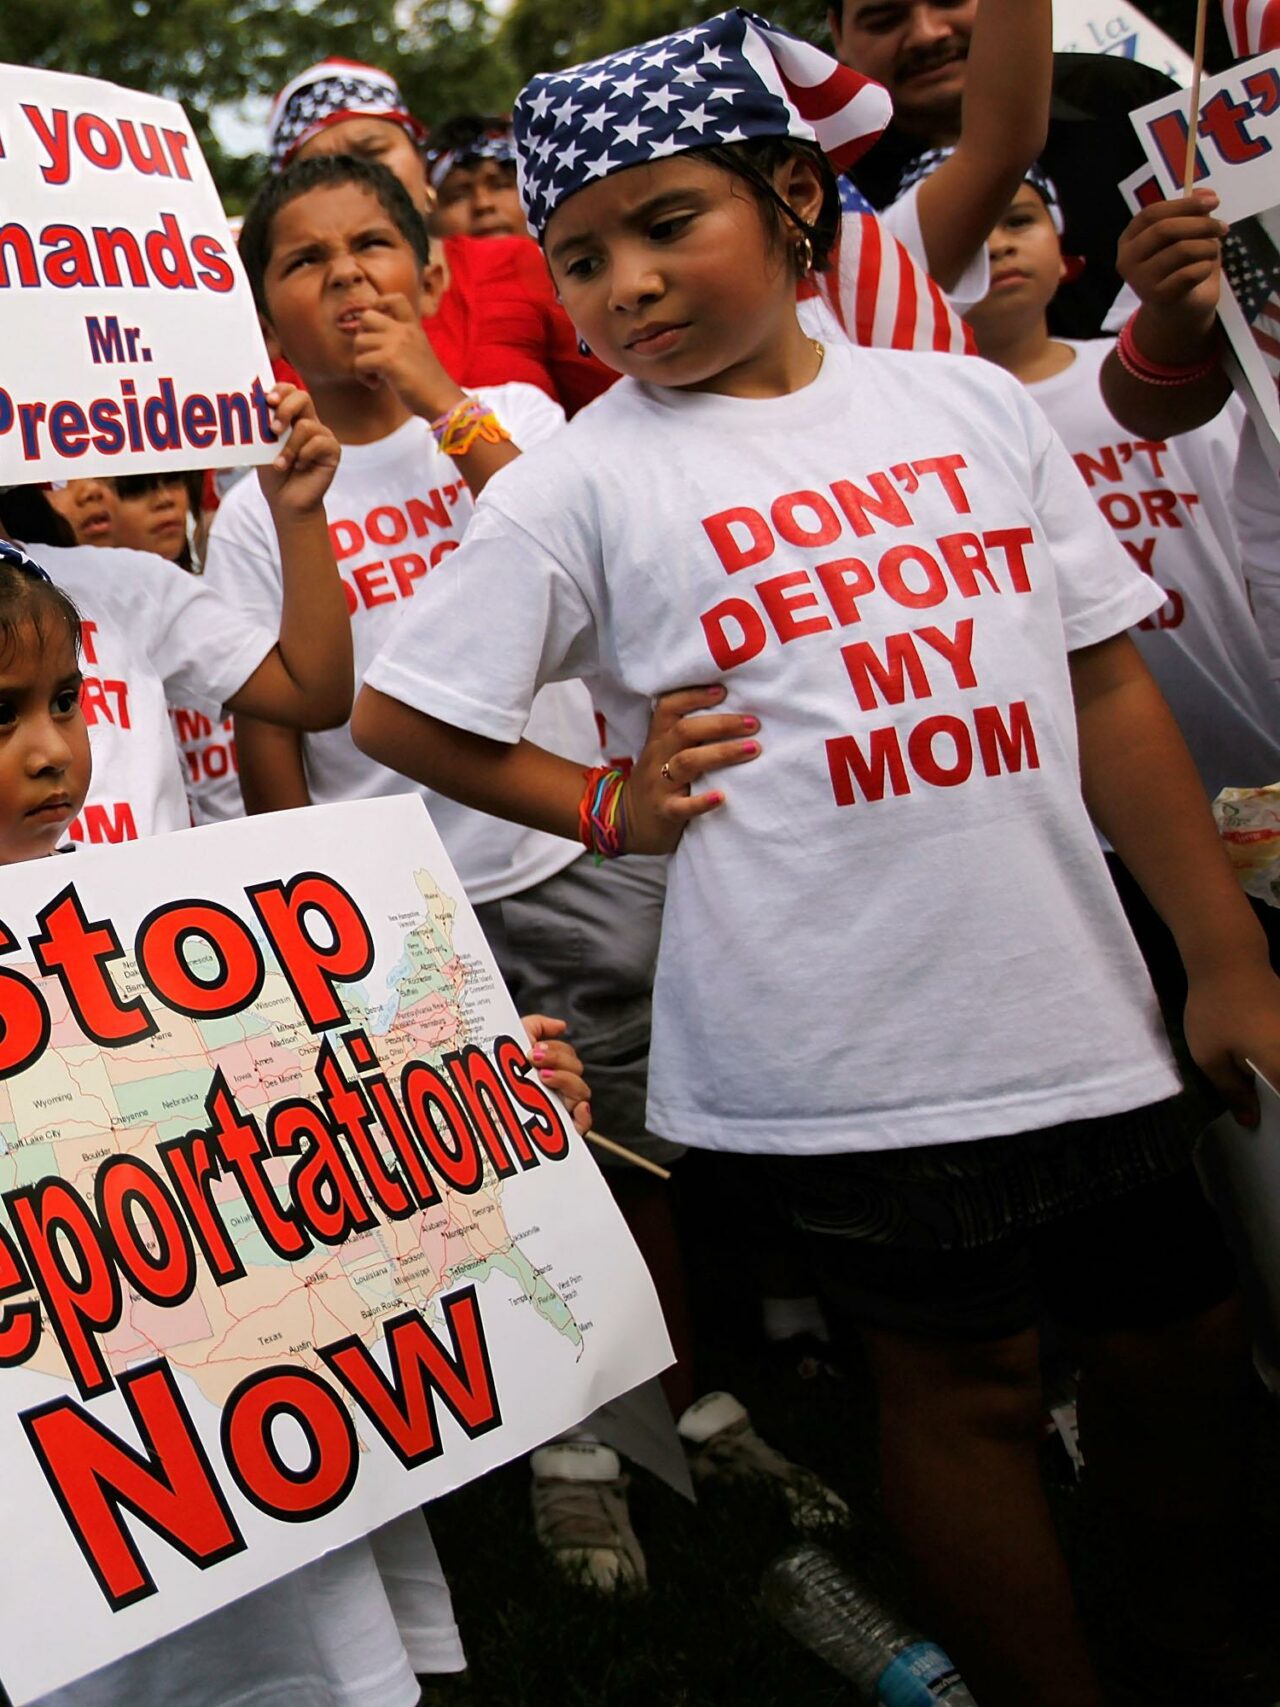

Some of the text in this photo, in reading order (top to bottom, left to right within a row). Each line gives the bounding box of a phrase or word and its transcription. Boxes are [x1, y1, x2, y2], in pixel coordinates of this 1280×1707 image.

[1147, 67, 1280, 190] It'
[23, 103, 193, 185] your
[85, 315, 152, 364] Mr.
[1072, 441, 1168, 487] N'T
[701, 453, 972, 577] DON'T
[1097, 489, 1199, 530] ORT
[700, 527, 1035, 672] DEPORT
[840, 617, 978, 713] MY
[825, 700, 1041, 808] MOM
[123, 960, 138, 969] Nor
[188, 954, 214, 966] nesota
[124, 970, 139, 979] Dak
[254, 995, 291, 1011] Wisconsin
[270, 1035, 298, 1049] Madison
[298, 1045, 320, 1057] Chica
[254, 1056, 274, 1068] Ames
[233, 1072, 252, 1083] Iowa
[33, 1092, 73, 1110] Wyoming
[162, 1093, 199, 1110] Nebraska
[111, 1108, 149, 1126] Cheyenne
[7, 1128, 62, 1151] Salt Lake City
[82, 1147, 112, 1162] Boulder
[472, 1204, 495, 1218] Georgia
[230, 1213, 254, 1228] Oklah
[421, 1218, 448, 1233] Alabama
[400, 1252, 425, 1267] Jackson
[353, 1267, 388, 1285] Louisiana
[393, 1267, 430, 1286] Mississippi
[360, 1305, 380, 1319] Baton
[257, 1331, 283, 1346] Texas
[288, 1340, 312, 1354] Austin
